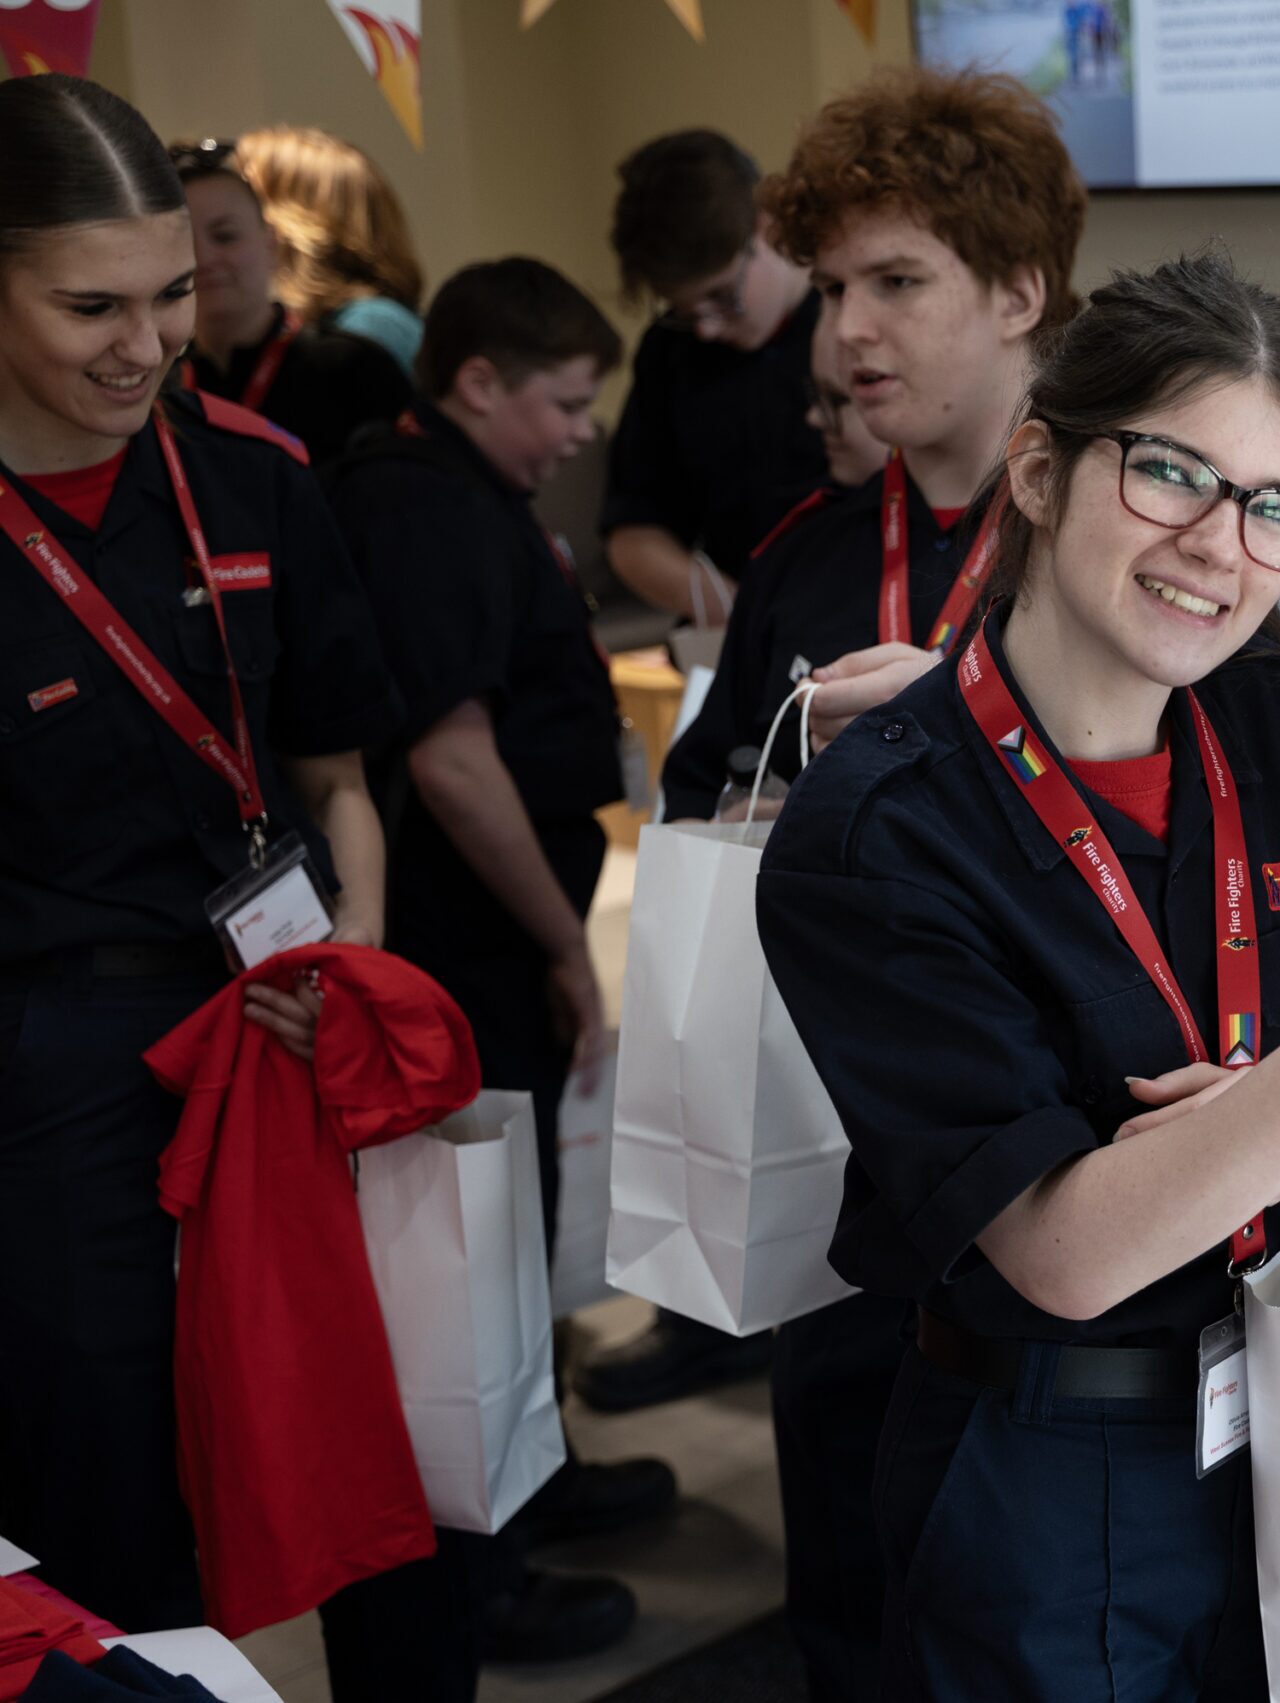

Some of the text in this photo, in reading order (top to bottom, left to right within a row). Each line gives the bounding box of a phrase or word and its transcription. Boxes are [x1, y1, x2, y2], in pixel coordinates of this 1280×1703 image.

[1082, 841, 1128, 911] Fire Fighters
[1227, 858, 1241, 933] Fire Fighters
[1237, 860, 1245, 888] Charity
[1102, 887, 1121, 914] Charity
